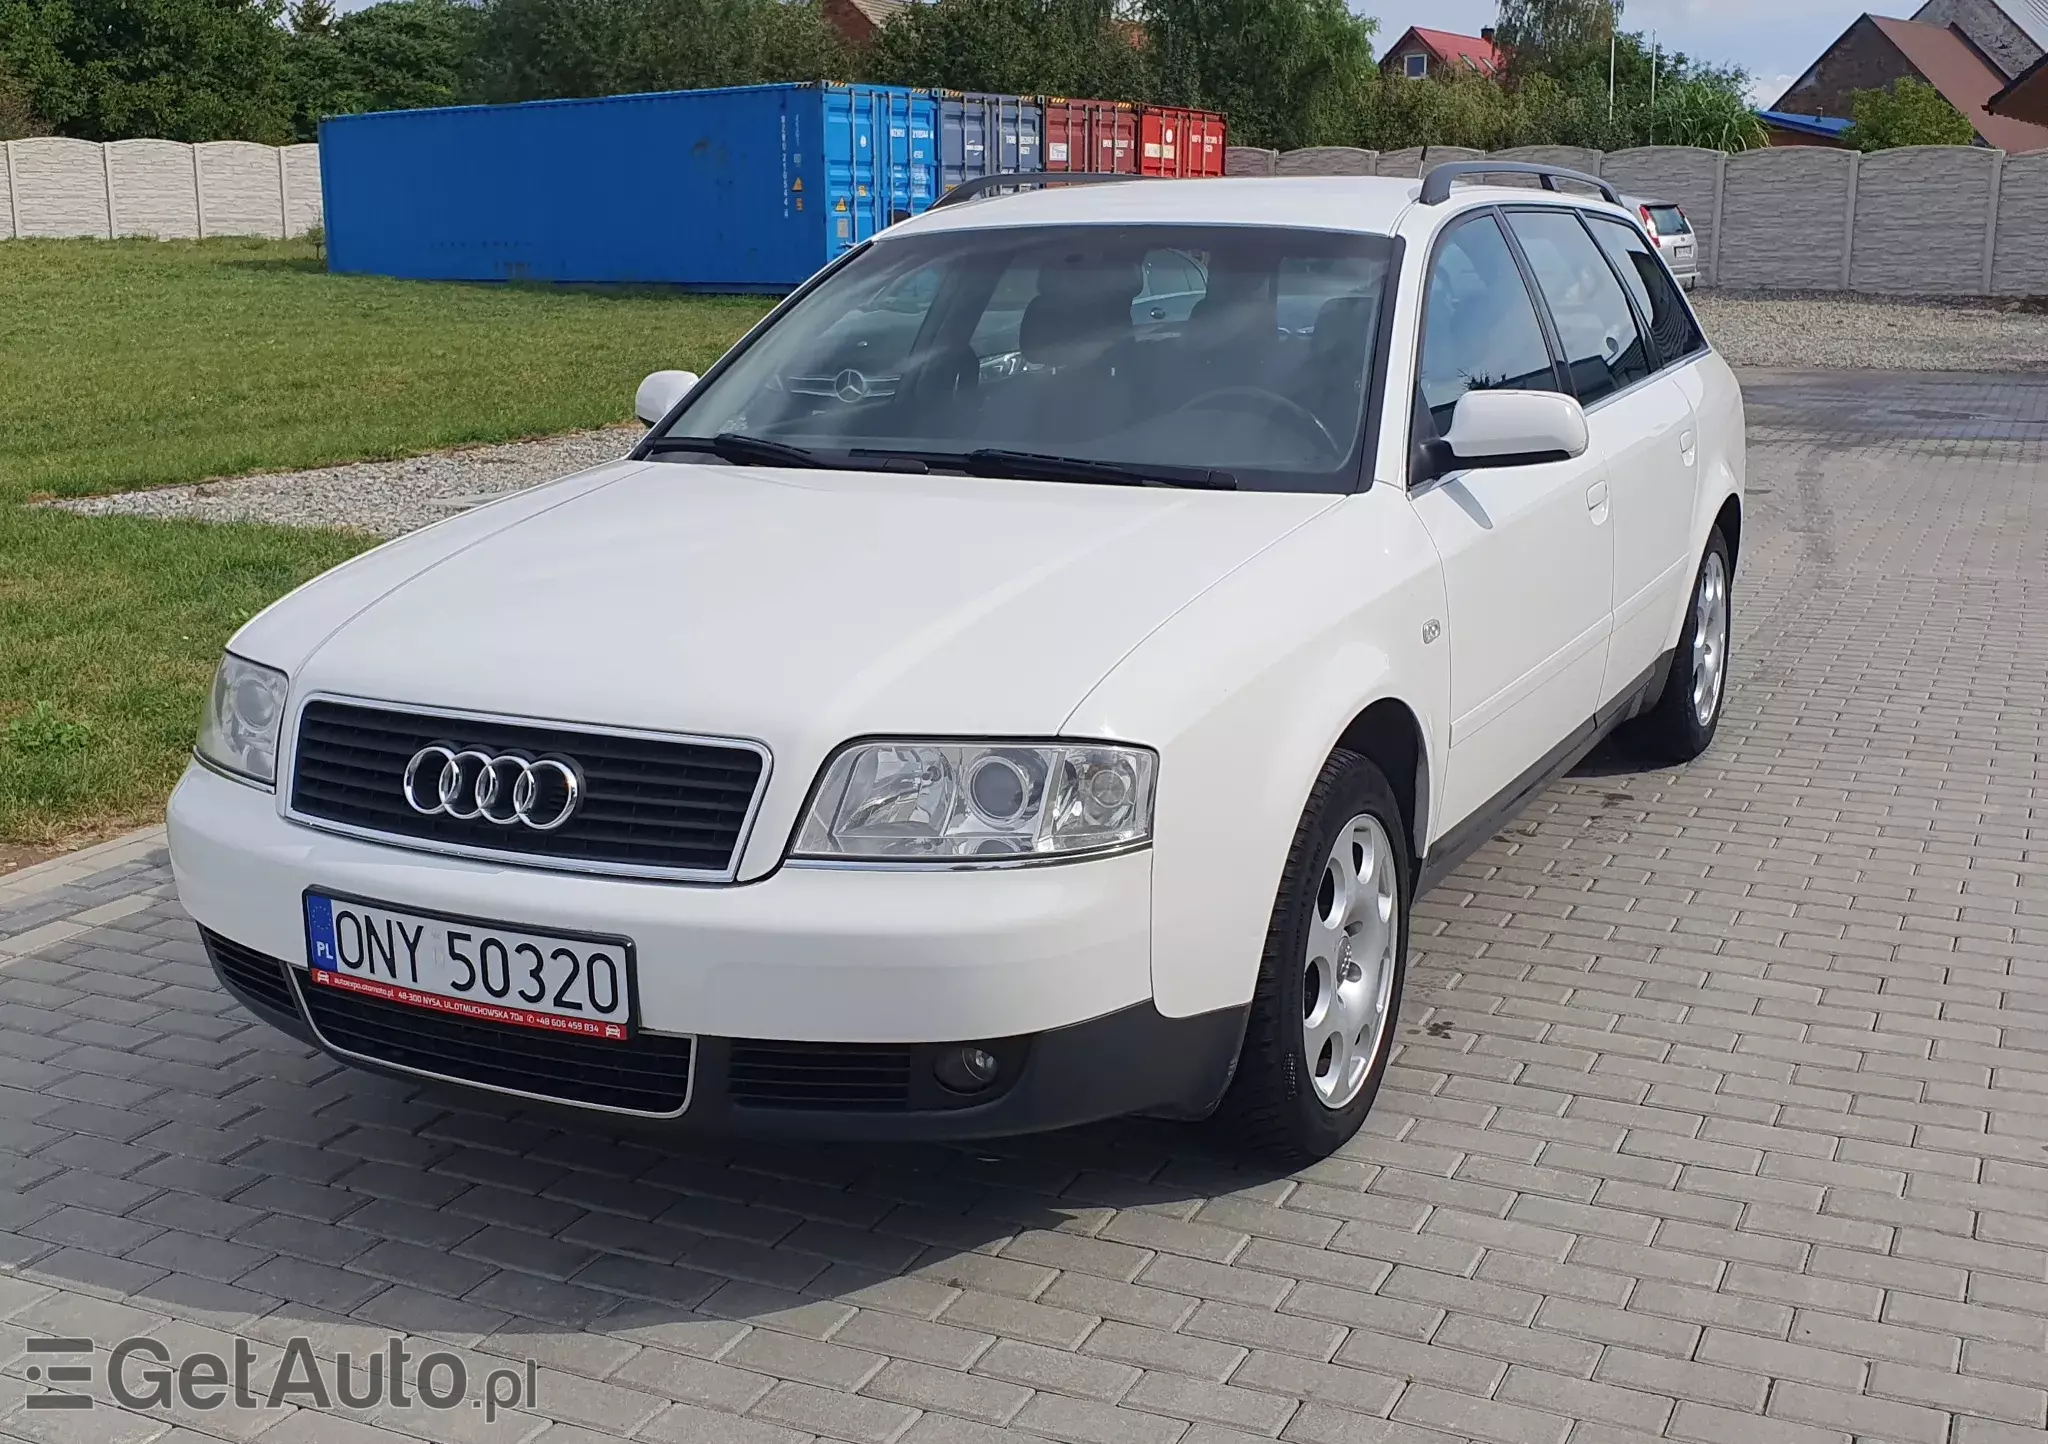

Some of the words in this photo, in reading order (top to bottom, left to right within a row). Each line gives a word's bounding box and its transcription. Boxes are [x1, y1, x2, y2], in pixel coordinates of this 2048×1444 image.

[316, 941, 334, 960] PL
[335, 911, 424, 983] ONY
[446, 930, 619, 1014] 50320
[334, 977, 394, 998] autoexpo.otomoto.pl
[398, 991, 421, 1004] 48-300
[510, 1012, 524, 1022] 70a
[536, 1017, 550, 1026] +48
[551, 1019, 566, 1028] 606
[567, 1022, 583, 1031] 459
